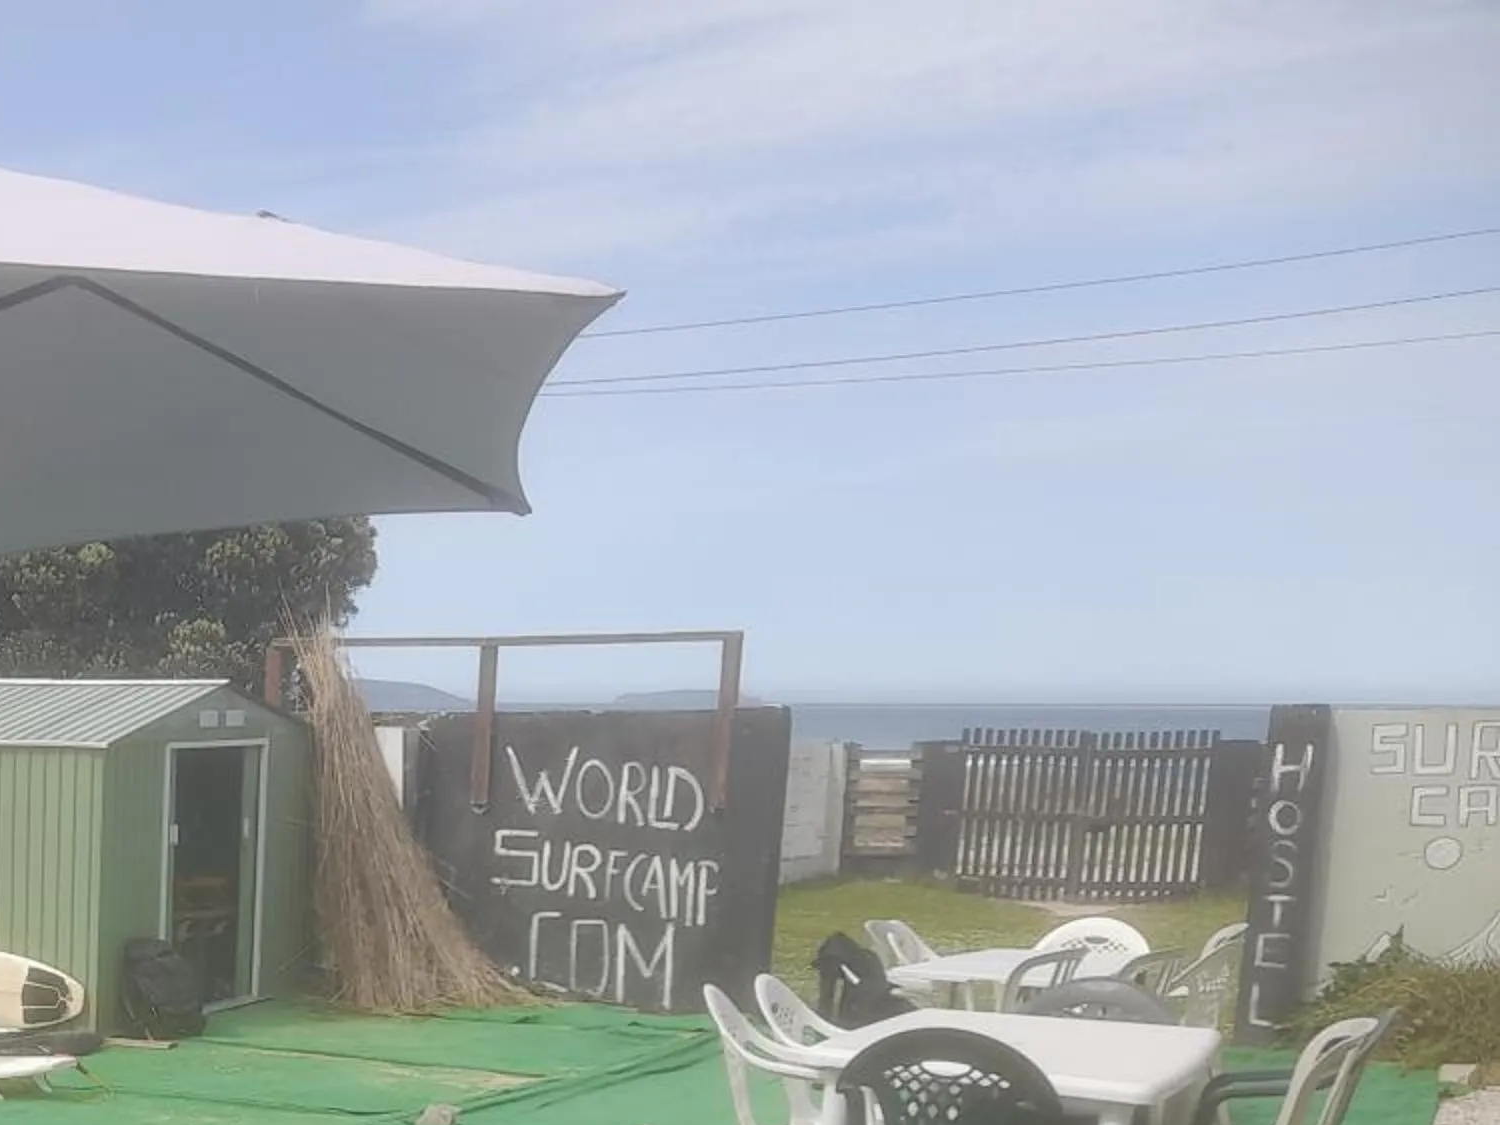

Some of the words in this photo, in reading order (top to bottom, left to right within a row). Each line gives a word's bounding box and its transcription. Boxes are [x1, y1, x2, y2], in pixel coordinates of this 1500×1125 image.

[505, 745, 704, 832] WORLD
[490, 828, 720, 926] SURFCAMP
[1249, 742, 1314, 1028] HOSTEL
